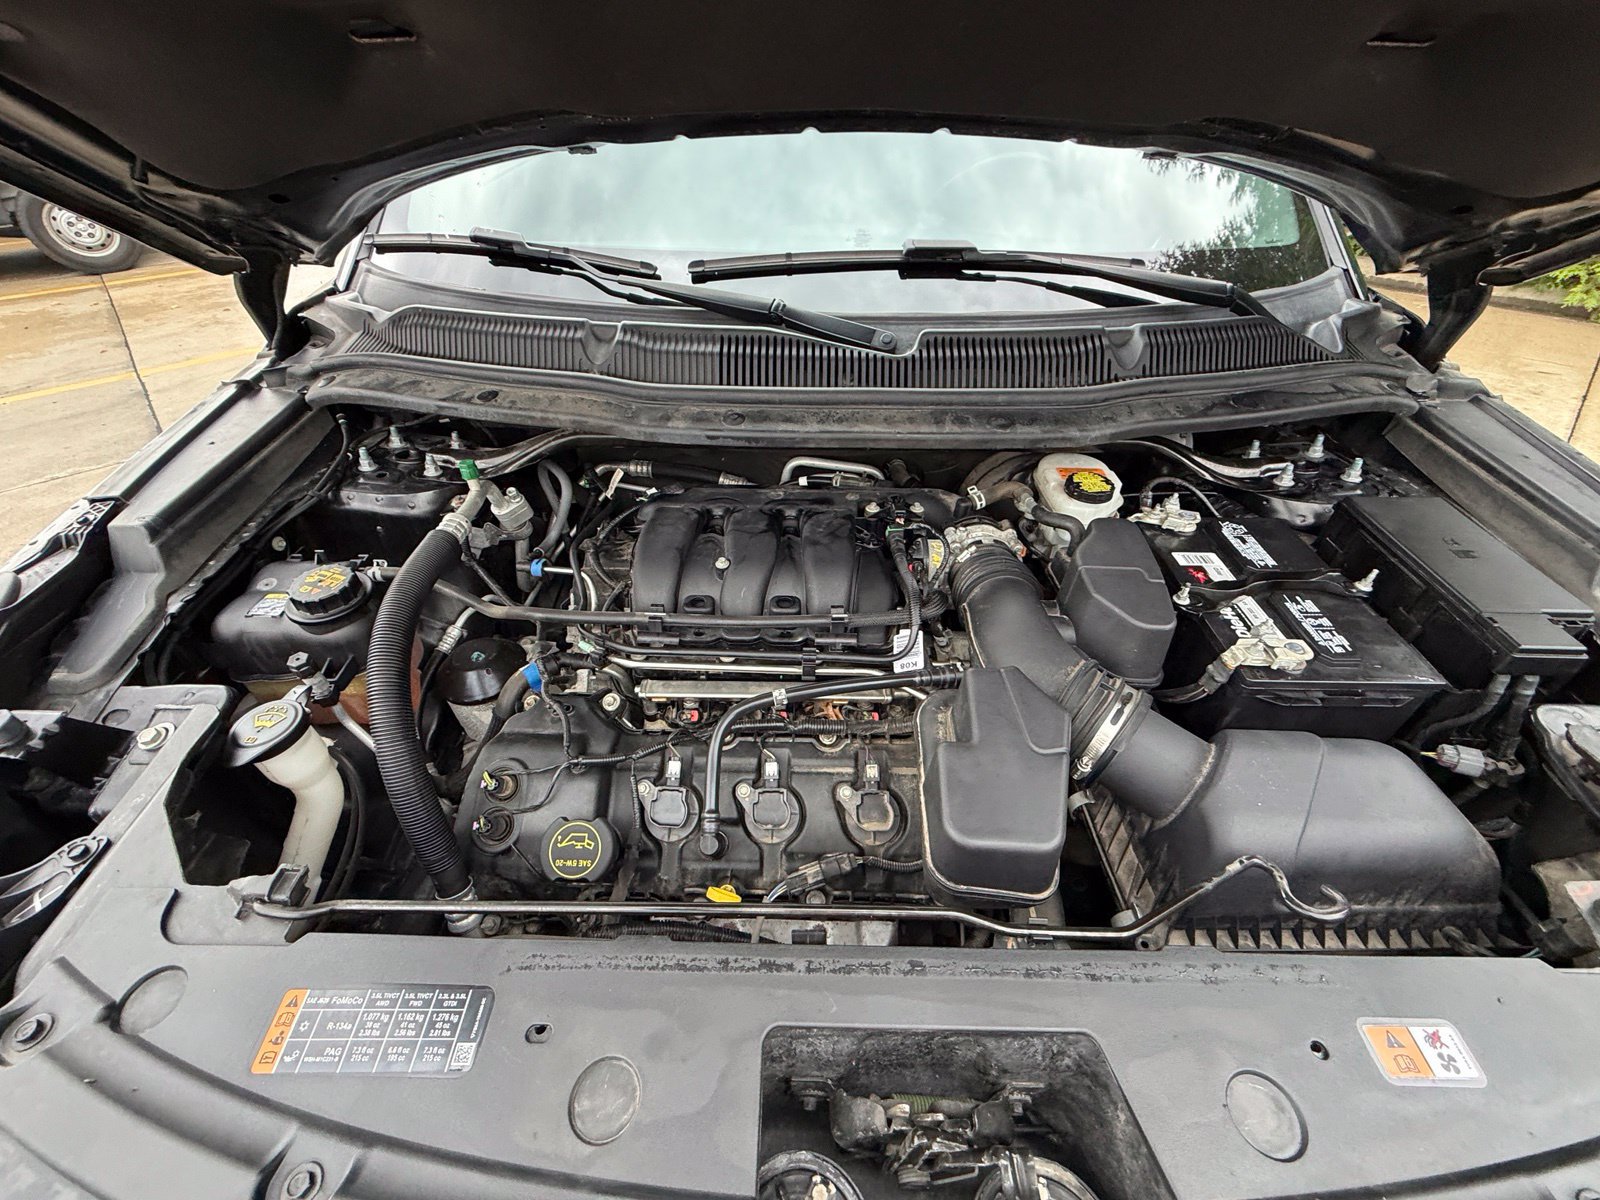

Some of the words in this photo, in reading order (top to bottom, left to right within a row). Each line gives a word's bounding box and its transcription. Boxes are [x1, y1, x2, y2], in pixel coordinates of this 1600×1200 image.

[1220, 606, 1252, 637] DieHa
[900, 661, 918, 669] K08
[331, 996, 364, 1004] FoMoCo
[381, 1013, 390, 1022] kg
[415, 1013, 424, 1022] kg
[450, 1013, 459, 1023] kg
[327, 1022, 352, 1030] R-134a
[324, 1047, 342, 1055] PAG
